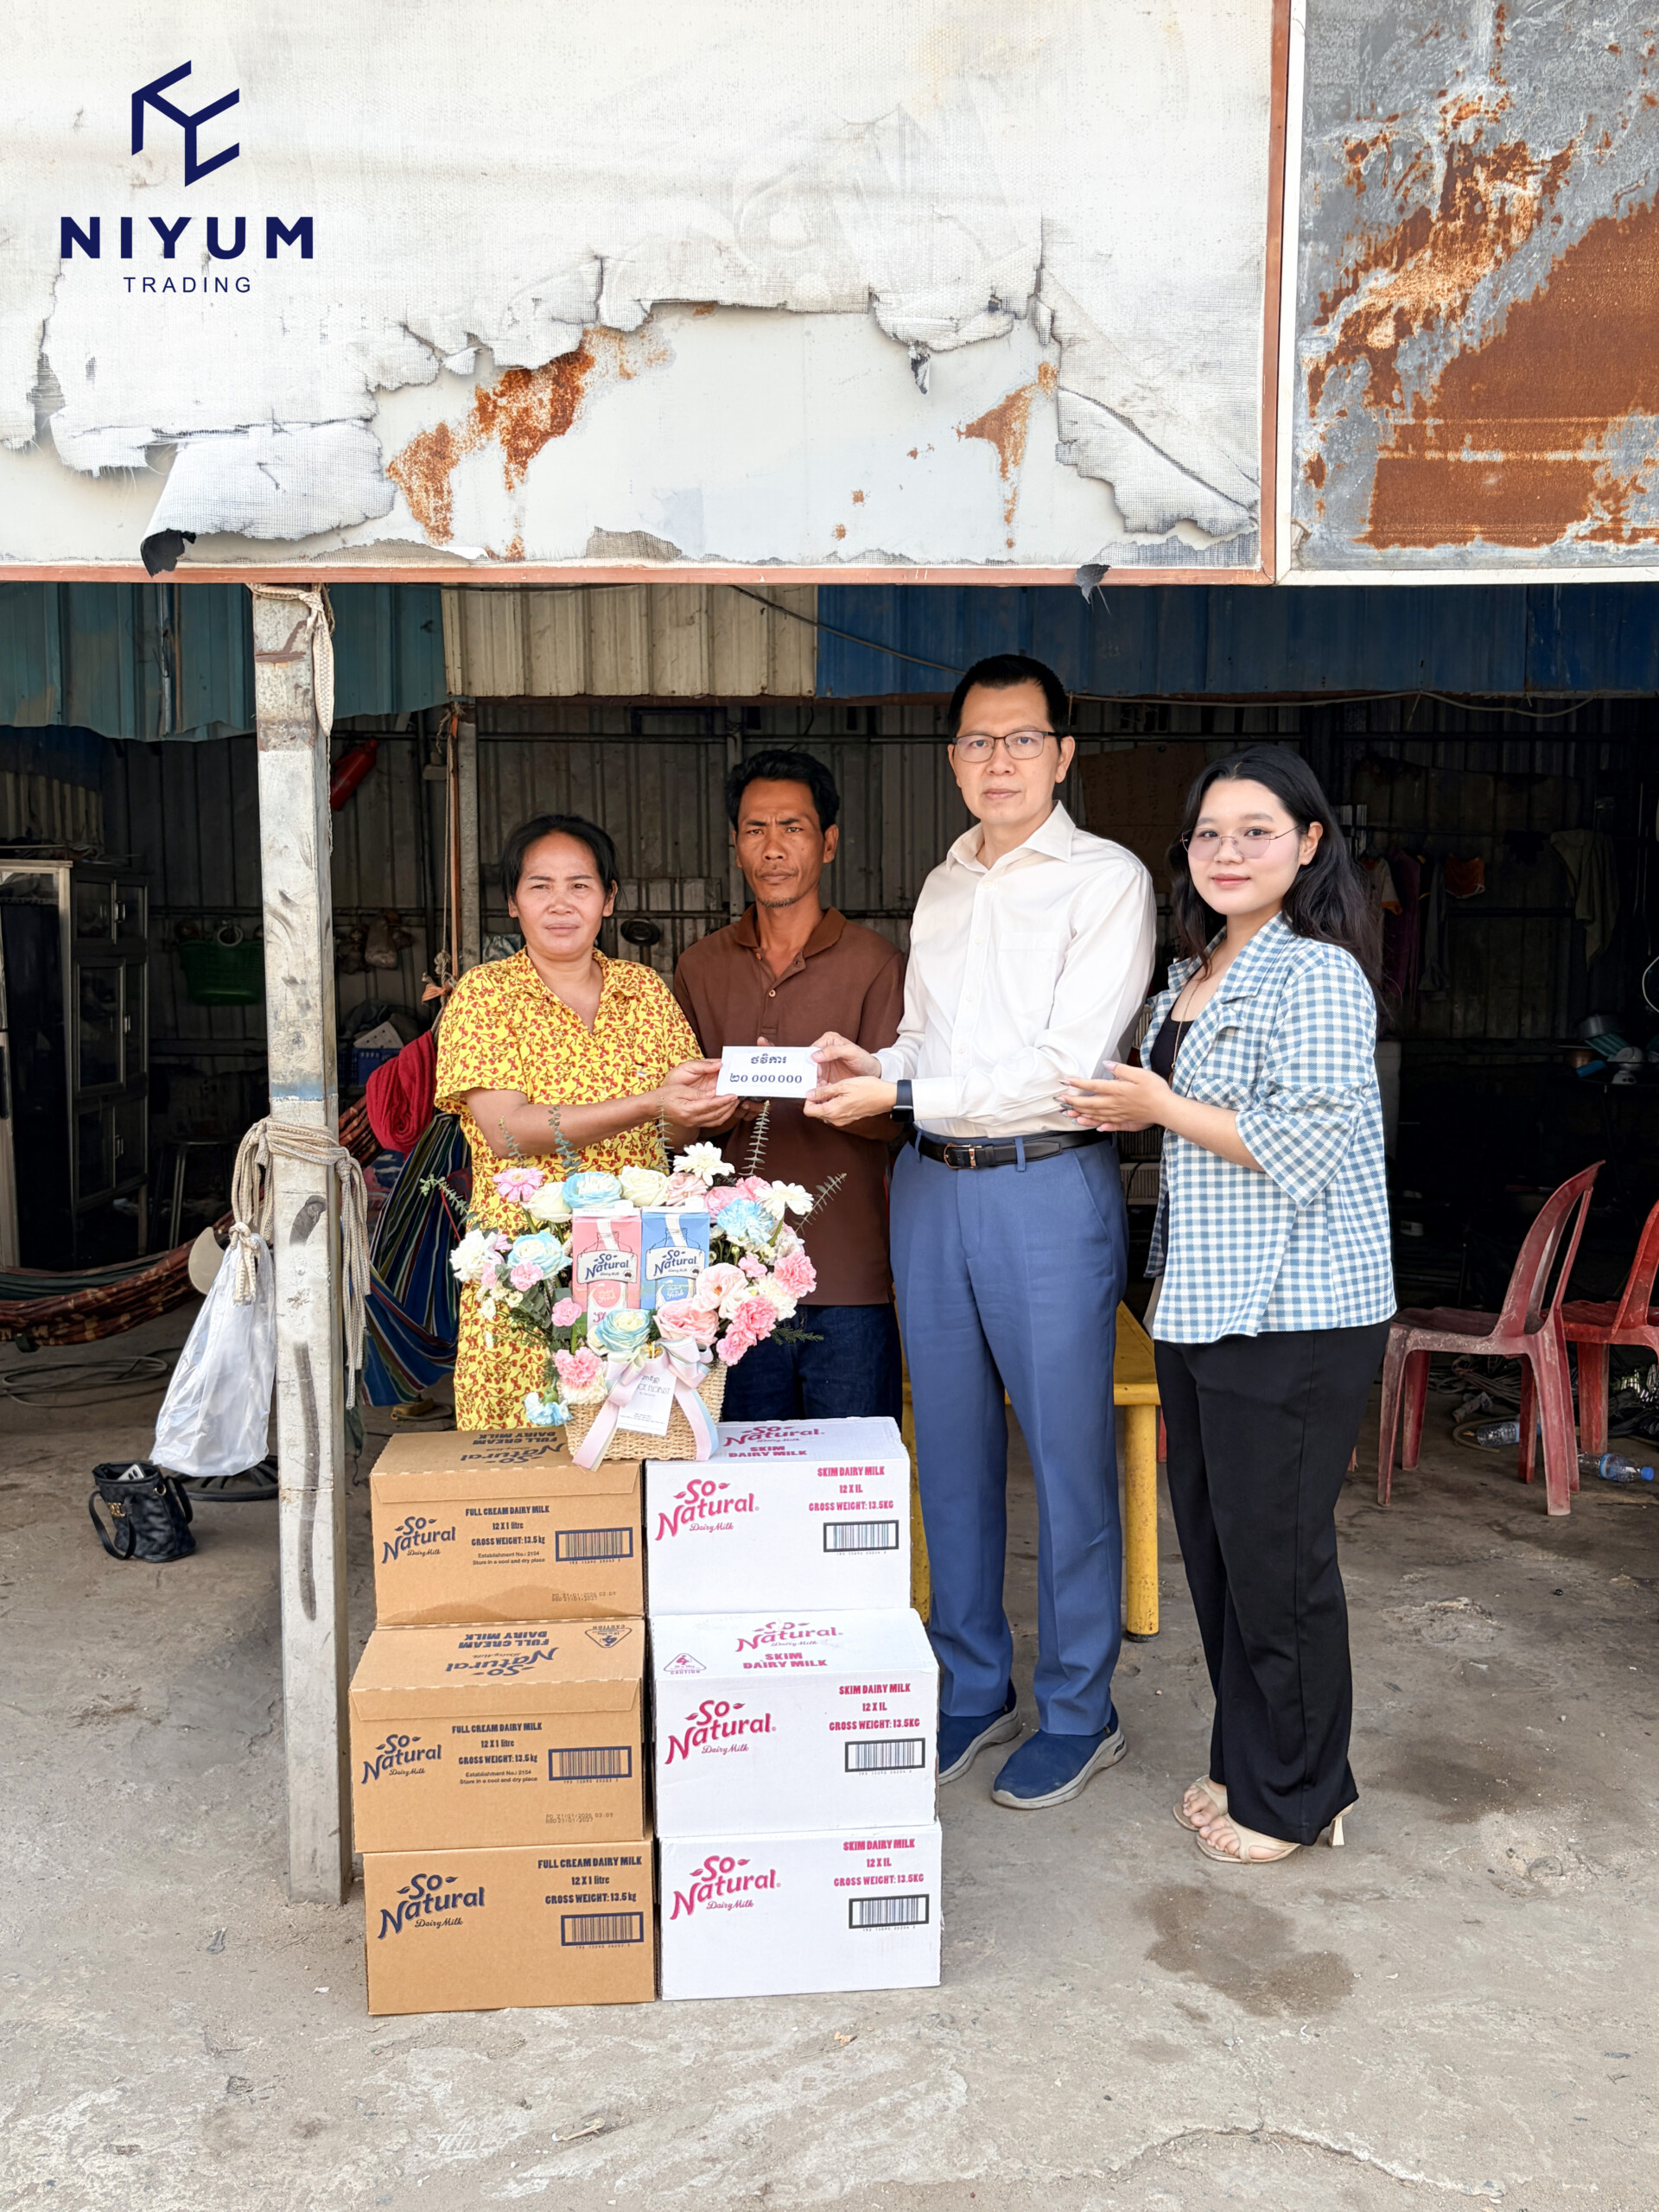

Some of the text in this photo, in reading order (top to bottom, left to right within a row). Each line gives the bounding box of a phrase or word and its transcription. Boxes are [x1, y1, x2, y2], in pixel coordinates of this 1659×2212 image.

[597, 1253, 612, 1264] So
[666, 1249, 680, 1261] So
[585, 1259, 629, 1281] Natural
[653, 1255, 696, 1277] Natural
[753, 1426, 781, 1434] So
[723, 1428, 819, 1447] Natural
[461, 1442, 566, 1461] Natural
[499, 1454, 532, 1464] So
[817, 1465, 885, 1478] SKIM DAIRY MILK
[683, 1478, 716, 1504] So
[839, 1484, 849, 1494] 12
[849, 1484, 855, 1493] X
[465, 1505, 550, 1516] FULL CREAM DAIRY MILK
[809, 1500, 894, 1512] GROSS WEIGHT: 13.5KG
[655, 1493, 755, 1541] Natural
[403, 1516, 426, 1535] So
[689, 1522, 734, 1533] Dairy Milk
[381, 1526, 456, 1564] Natural
[496, 1536, 523, 1545] WEIGHT:
[524, 1535, 537, 1544] 13.5
[538, 1535, 545, 1545] kg
[465, 1630, 548, 1641] DAIRY MILK
[735, 1627, 836, 1652] Natural
[458, 1639, 512, 1649] CREAM
[445, 1647, 560, 1672] Natural
[743, 1659, 829, 1669] DAIRY MILK
[486, 1664, 524, 1676] So
[838, 1683, 911, 1695] SKIM DAIRY MILK
[696, 1700, 730, 1726] So
[862, 1703, 871, 1712] 12
[872, 1702, 878, 1711] X
[471, 1724, 499, 1732] CREAM
[499, 1723, 522, 1732] DAIRY
[523, 1722, 543, 1731] MILK
[829, 1718, 920, 1732] GROSS WEIGHT: 13.5KG
[385, 1733, 410, 1754] So
[500, 1738, 514, 1747] litre
[664, 1713, 772, 1764] Natural
[701, 1744, 749, 1756] Dairy Milk
[361, 1745, 442, 1784] Natural
[458, 1753, 537, 1764] GROSS WEIGHT: 13.5 kg
[842, 1839, 915, 1851] SKIM DAIRY MILK
[537, 1856, 642, 1869] FULL CREAM DAIRY MILK
[701, 1855, 735, 1882] So
[867, 1859, 875, 1867] 12
[876, 1858, 882, 1867] X
[571, 1876, 581, 1885] 12
[581, 1876, 588, 1885] X
[594, 1874, 610, 1885] litre
[834, 1873, 924, 1887] GROSS WEIGHT: 13.5KG
[408, 1873, 443, 1900] So
[544, 1891, 637, 1904] GROSS WEIGHT: 13.5 kg
[670, 1869, 777, 1920] Natural
[706, 1899, 754, 1911] Dairy Milk
[377, 1886, 485, 1940] Natural
[414, 1917, 464, 1929] Dairy Milk
